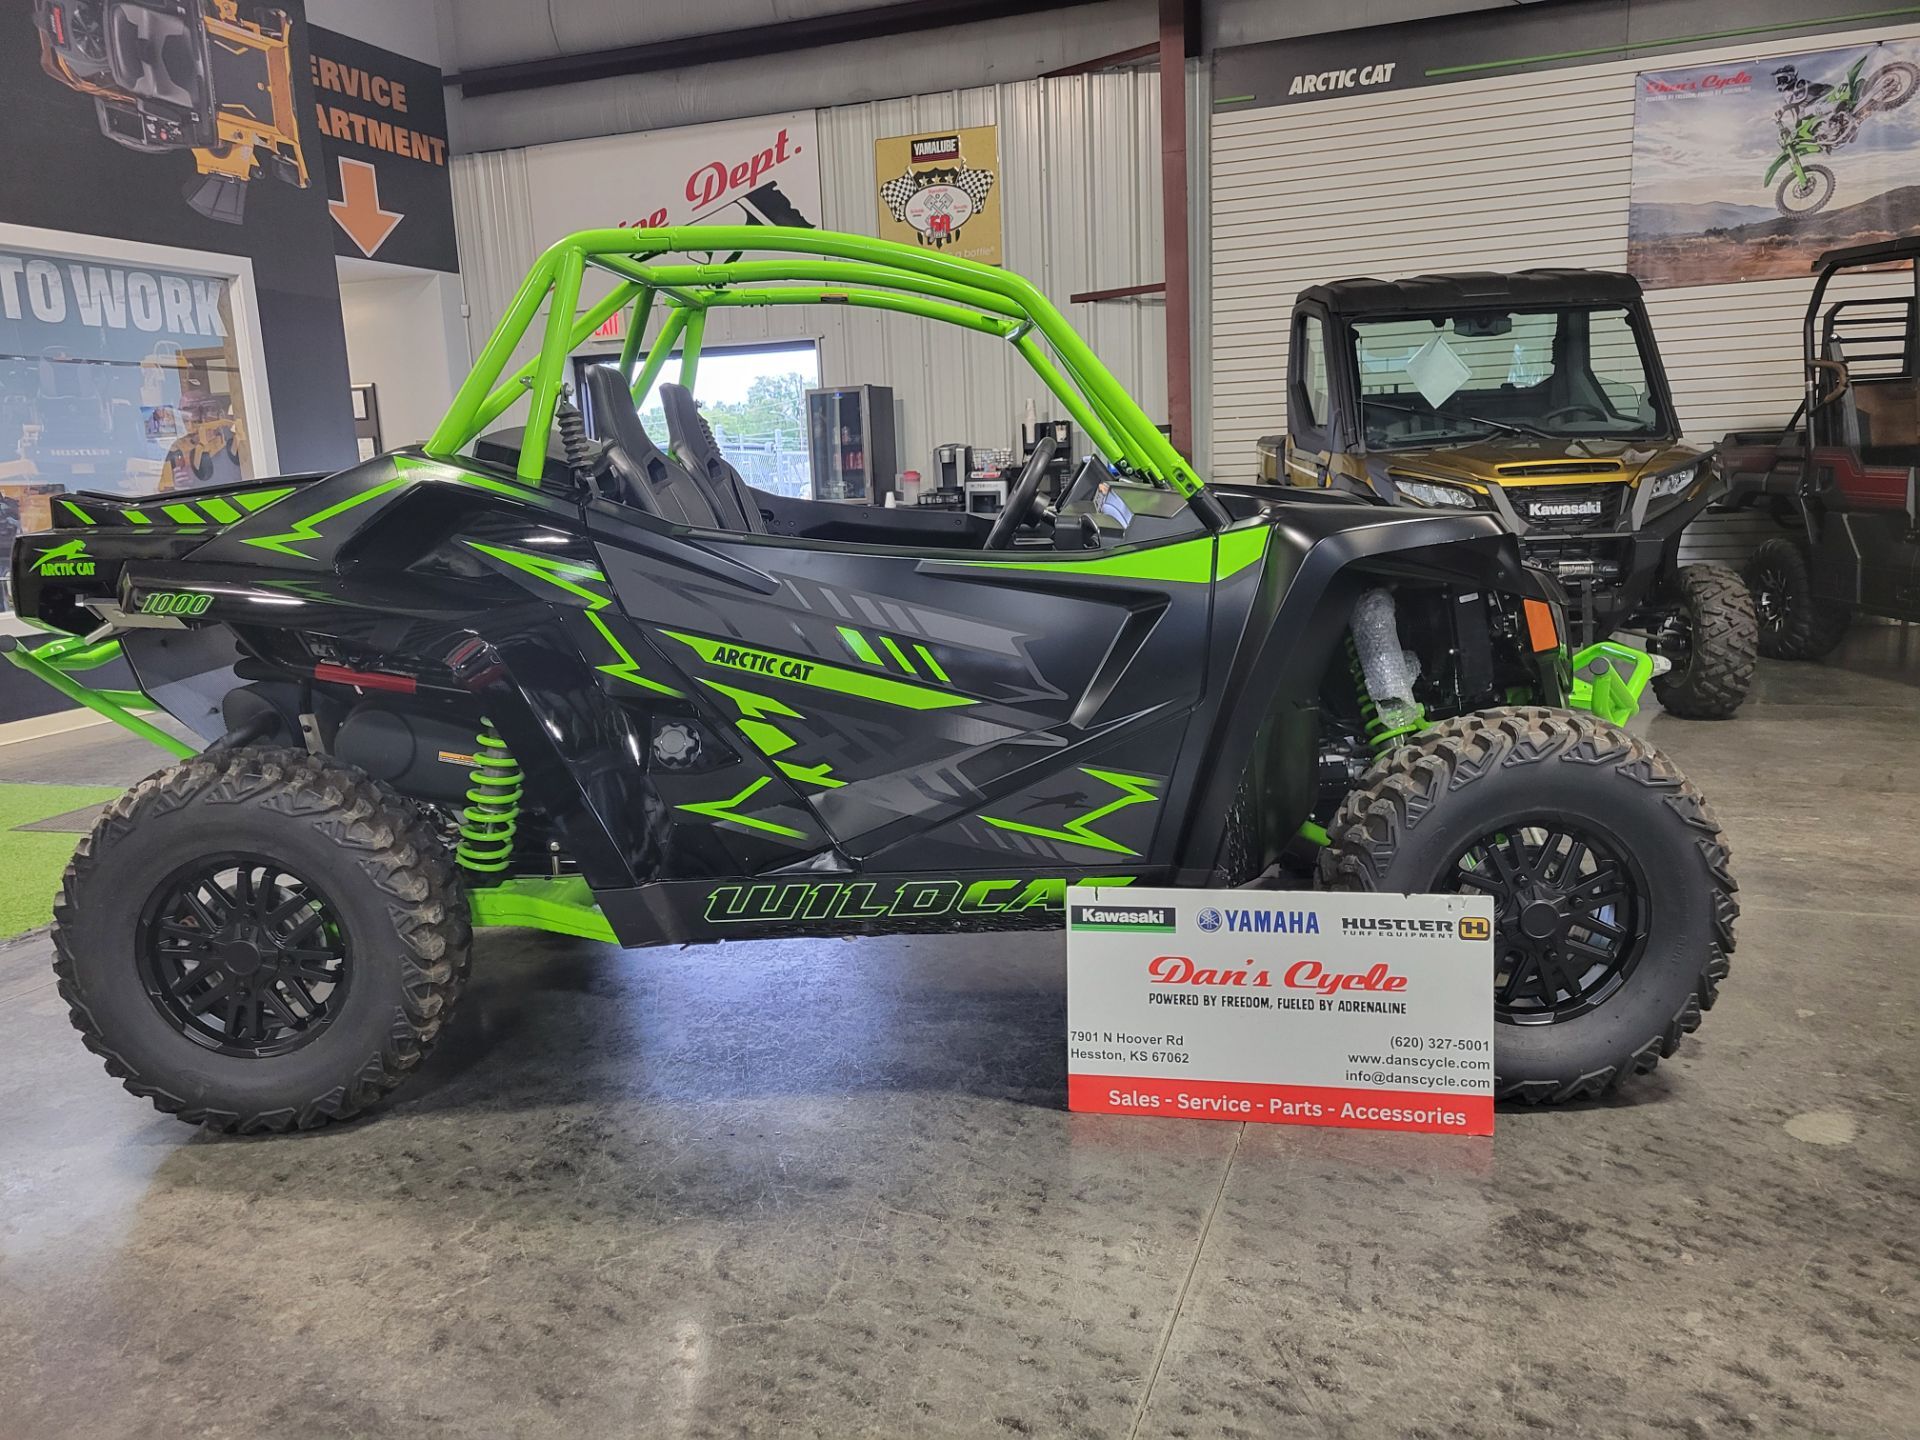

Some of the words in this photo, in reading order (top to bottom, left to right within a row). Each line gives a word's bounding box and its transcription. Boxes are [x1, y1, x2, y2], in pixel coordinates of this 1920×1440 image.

[1288, 68, 1357, 95] ARCTIC
[1360, 63, 1396, 86] CAT
[1702, 71, 1752, 89] Cycle
[913, 139, 957, 156] YAMALUBE
[686, 128, 802, 211] Dept.
[0, 256, 67, 323] TO
[68, 264, 229, 337] WORK
[595, 311, 619, 336] XIT
[1528, 501, 1601, 516] Kawasaki
[41, 563, 76, 576] ARCTIC
[76, 562, 96, 576] CAT
[141, 593, 215, 615] 1000
[712, 646, 778, 674] ARCTIC
[779, 661, 814, 681] CAT
[1082, 908, 1165, 924] Kawasaki
[1225, 909, 1320, 935] YAMAHA
[1342, 917, 1454, 931] HUSTLER
[1379, 931, 1453, 939] EQUIPMENT
[1149, 956, 1273, 987] Dan's
[1284, 961, 1408, 995] Cycle
[1149, 993, 1199, 1006] POWERED
[1203, 995, 1217, 1007] BY
[1221, 996, 1273, 1010] FREEDOM,
[1277, 997, 1315, 1011] FUELED
[1319, 999, 1334, 1012] BY
[1337, 1000, 1407, 1015] ADRENALINE
[1070, 1031, 1099, 1043] 7901
[1103, 1032, 1113, 1043] N
[1116, 1033, 1162, 1046] Hoover
[1166, 1034, 1184, 1046] Rd
[1390, 1035, 1424, 1050] (620)
[1428, 1038, 1490, 1052] 327-5001
[1071, 1048, 1126, 1063] Hesston,
[1130, 1051, 1148, 1062] KS
[1151, 1052, 1190, 1064] 67062
[1347, 1054, 1491, 1070] www.danscycle.com
[1345, 1070, 1491, 1089] info@danscycle.com
[1108, 1089, 1160, 1108] Sales
[1177, 1093, 1251, 1113] Service
[1269, 1099, 1323, 1117] Parts
[1340, 1102, 1467, 1126] Accessories
